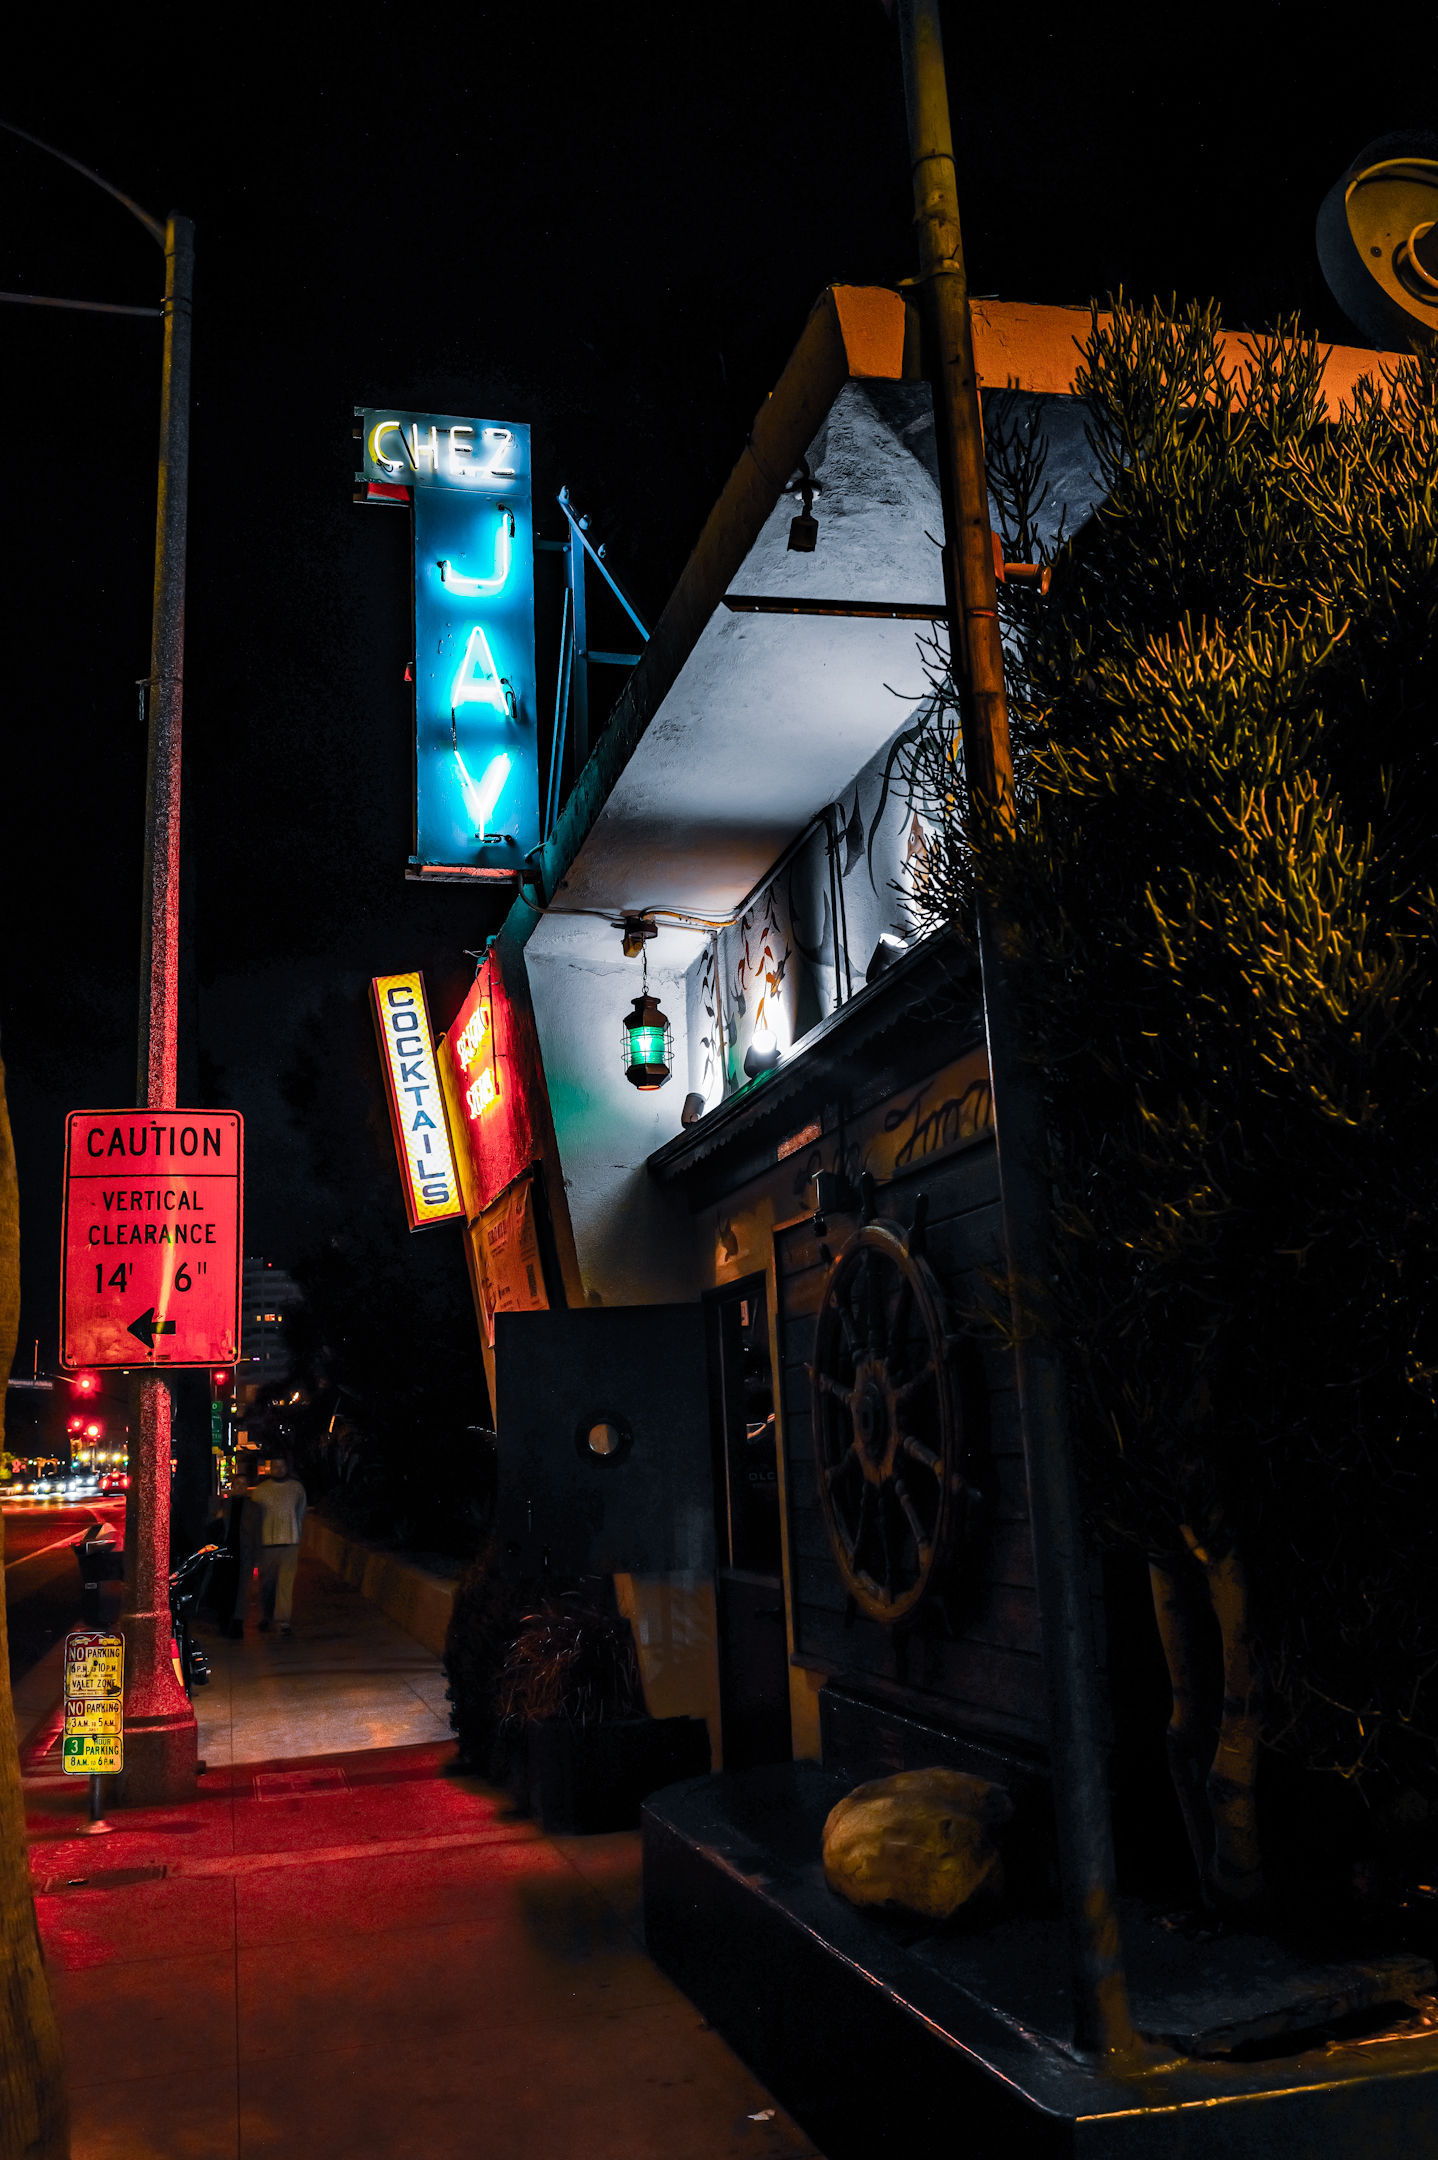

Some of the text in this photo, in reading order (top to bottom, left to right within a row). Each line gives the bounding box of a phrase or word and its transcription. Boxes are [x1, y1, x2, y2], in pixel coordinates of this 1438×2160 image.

[369, 420, 515, 478] CHEZ
[440, 512, 513, 841] JAY
[387, 986, 450, 1206] COCKTAILS
[87, 1127, 221, 1157] CAUTION
[102, 1190, 204, 1211] VERTICAL
[89, 1224, 217, 1245] CLEARANCE
[95, 1261, 207, 1294] 14' 6"
[68, 1646, 120, 1661] NO PARKING
[72, 1679, 116, 1688] VALET ZONE
[67, 1701, 119, 1716] NO PARKING
[71, 1718, 77, 1727] 3
[98, 1718, 103, 1726] 5
[70, 1740, 78, 1753] 3
[85, 1746, 119, 1755] PARKING
[70, 1757, 76, 1766] 8
[98, 1757, 103, 1766] 6
